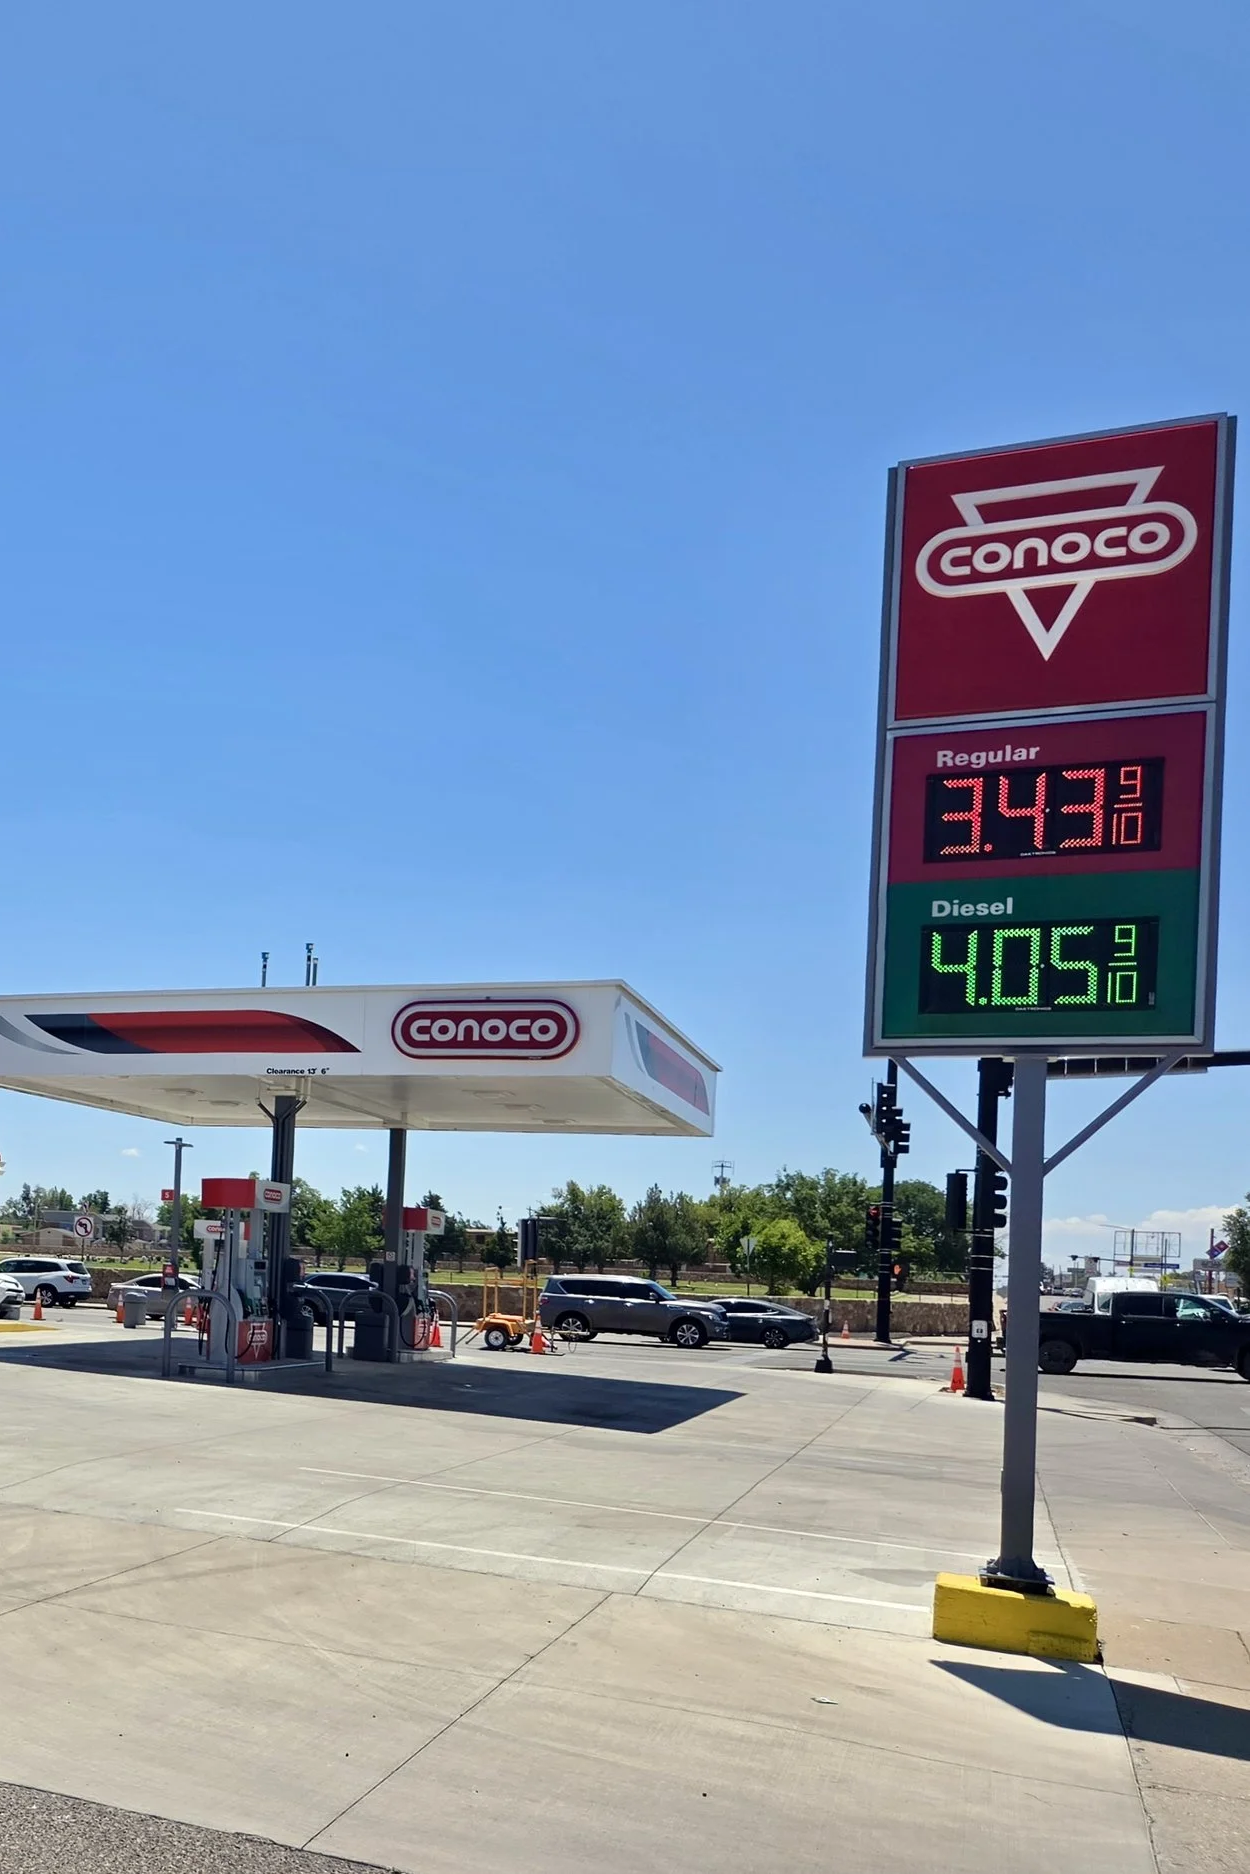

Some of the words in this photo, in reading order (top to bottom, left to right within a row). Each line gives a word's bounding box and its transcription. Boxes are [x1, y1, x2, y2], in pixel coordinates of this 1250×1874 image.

[936, 744, 1040, 769] Regular
[939, 768, 1105, 855] 3.43
[931, 896, 1014, 918] Diesel
[931, 925, 1098, 1007] 4.05
[266, 1067, 305, 1075] Clearance
